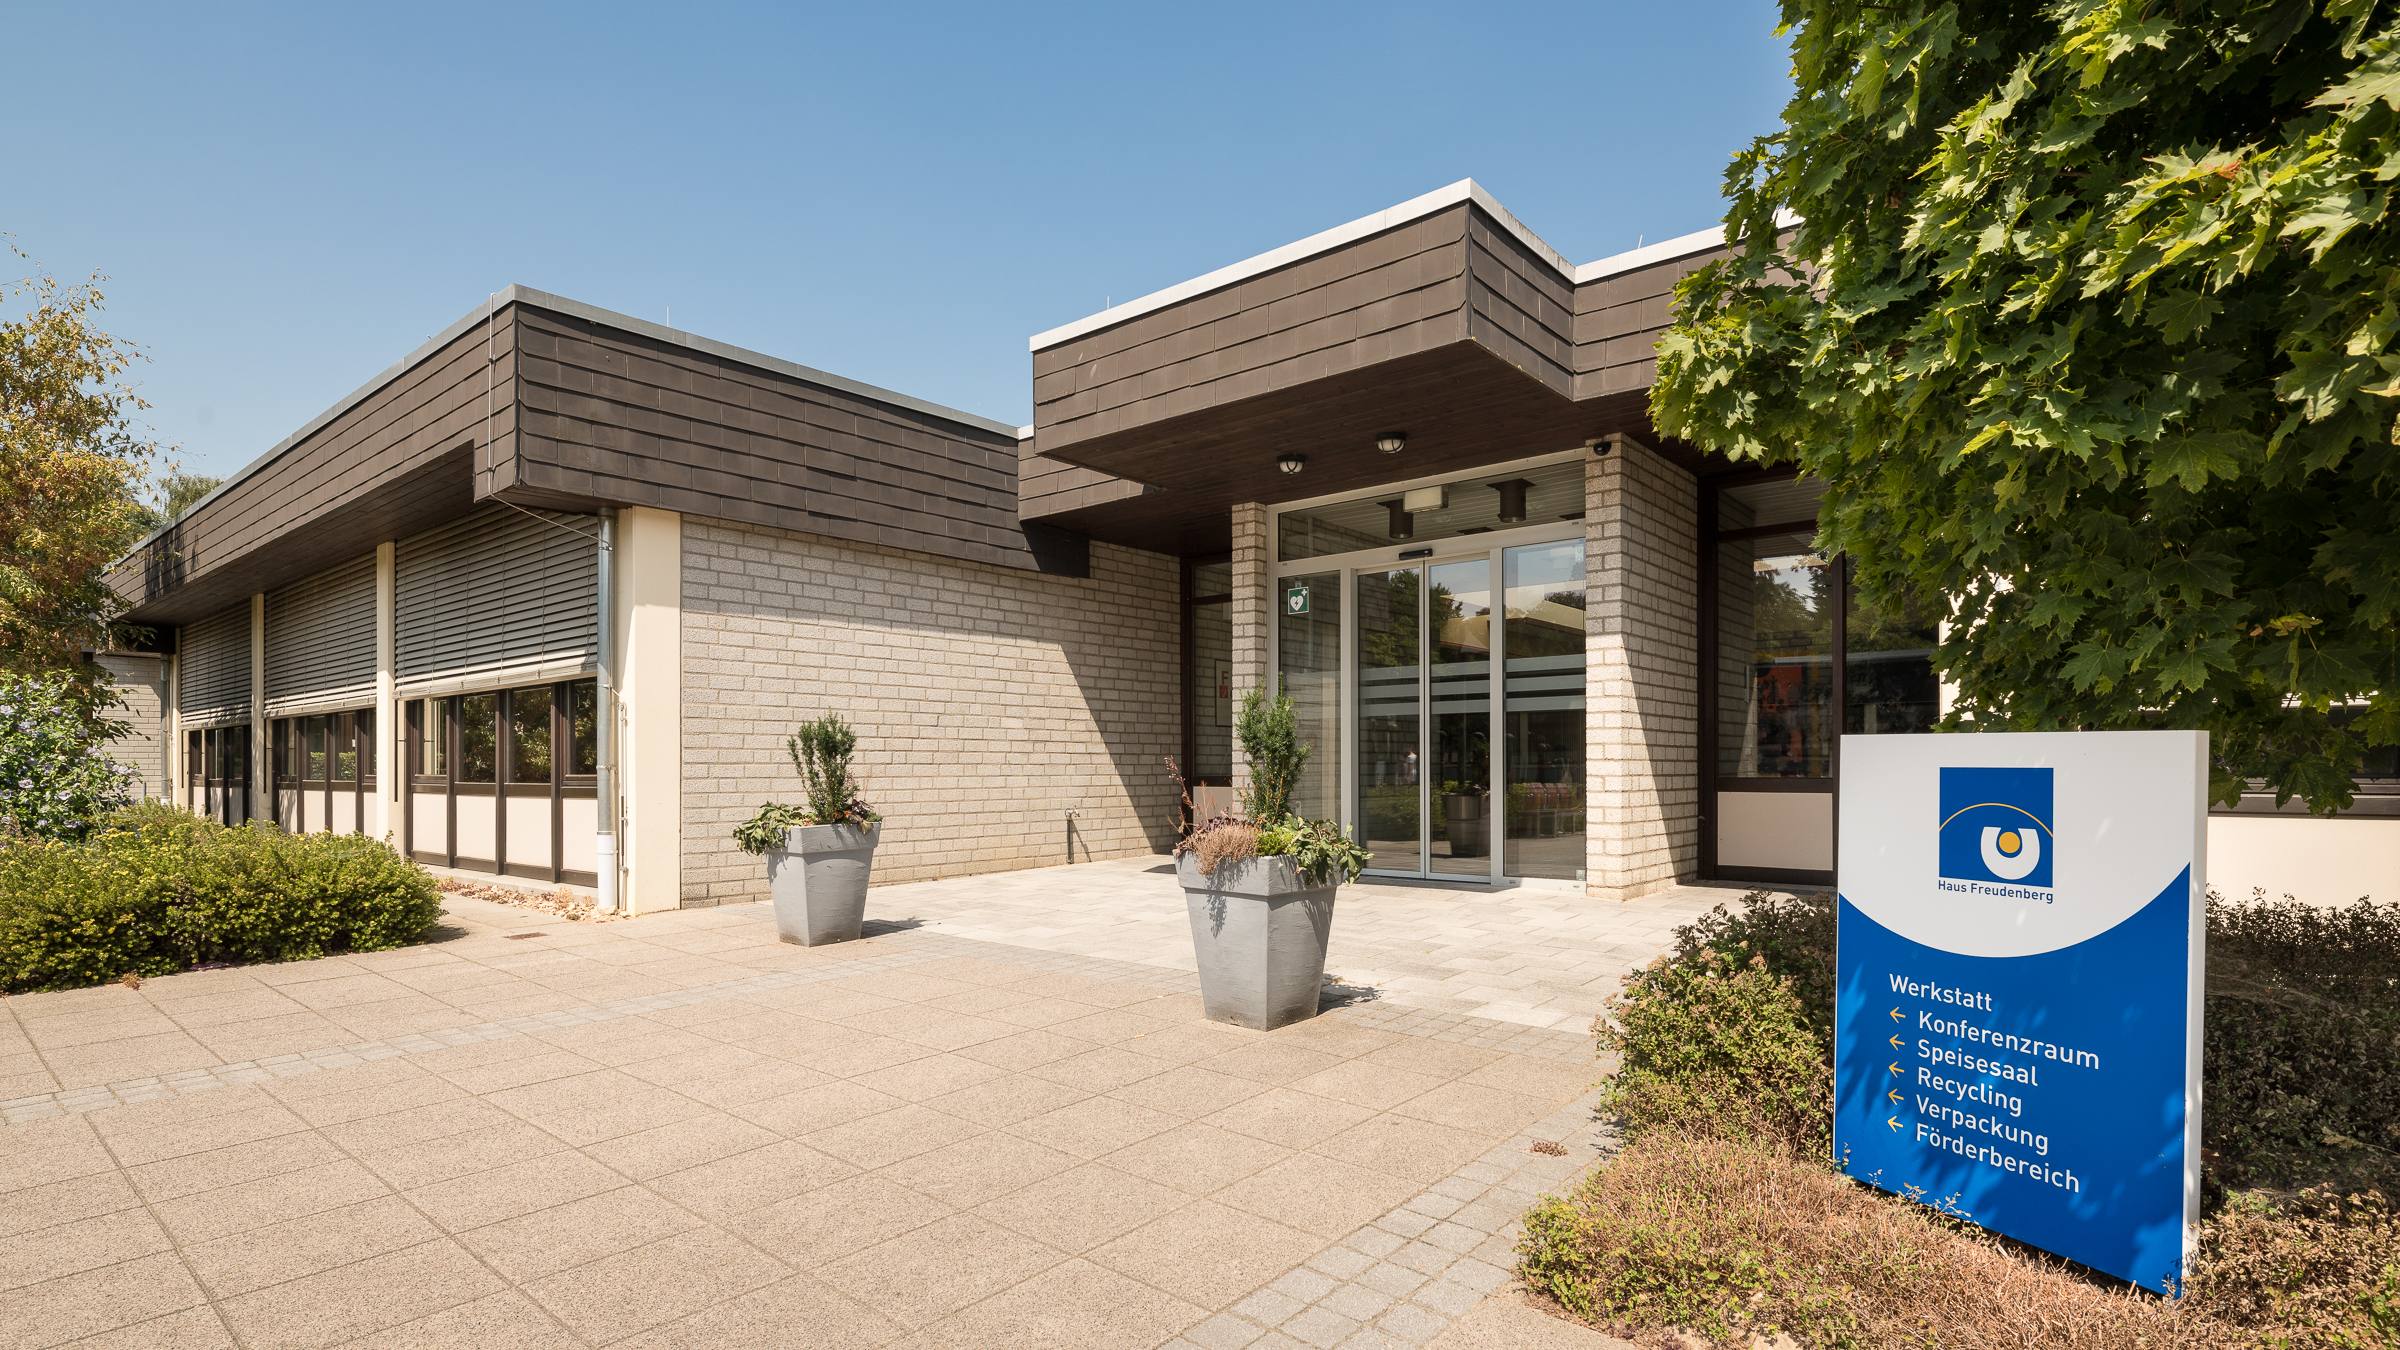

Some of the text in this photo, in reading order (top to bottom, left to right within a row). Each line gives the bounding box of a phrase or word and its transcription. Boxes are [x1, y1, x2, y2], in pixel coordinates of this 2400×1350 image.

[1938, 880, 2054, 904] Haus Freudenberg
[1889, 973, 1992, 1012] Werkstatt
[1918, 1038, 2038, 1087] Speisesaal
[1919, 1010, 2100, 1070] Konferenzraum
[1918, 1066, 2022, 1118] Recycling
[1916, 1094, 2048, 1156] Verpackung
[1916, 1122, 2079, 1193] Förderbereich
